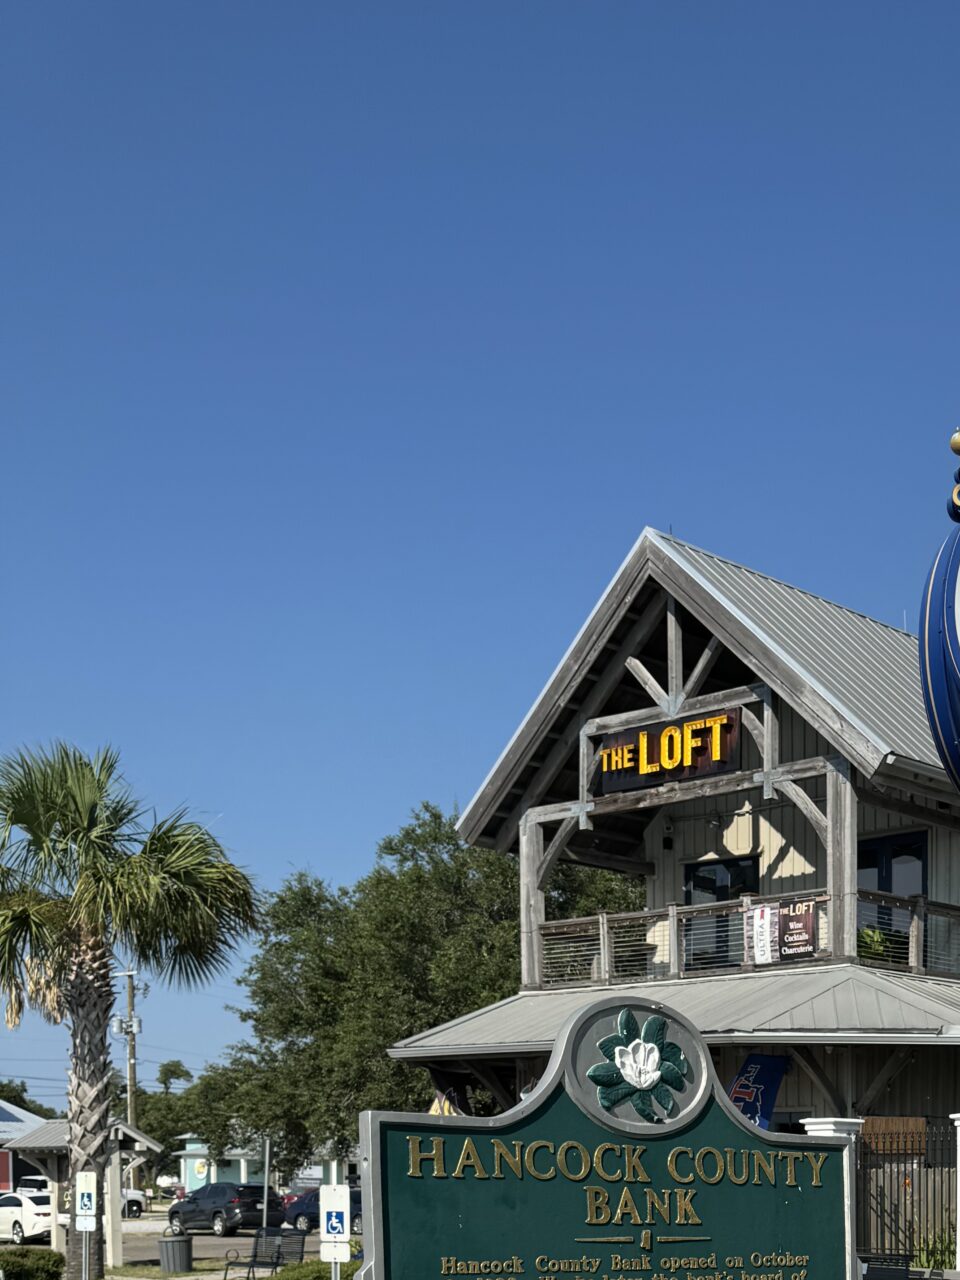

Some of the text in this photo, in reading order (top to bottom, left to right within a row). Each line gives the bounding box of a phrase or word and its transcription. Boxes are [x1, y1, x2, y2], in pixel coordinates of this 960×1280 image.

[601, 715, 728, 775] THE LOFT
[790, 902, 814, 916] LOFT
[785, 933, 808, 942] Cocktails
[782, 945, 813, 955] Charcuterie
[406, 1136, 828, 1187] HANCOCK COUNTY
[584, 1185, 702, 1226] BANK
[441, 1252, 809, 1274] Hancock County Bank opened on October
